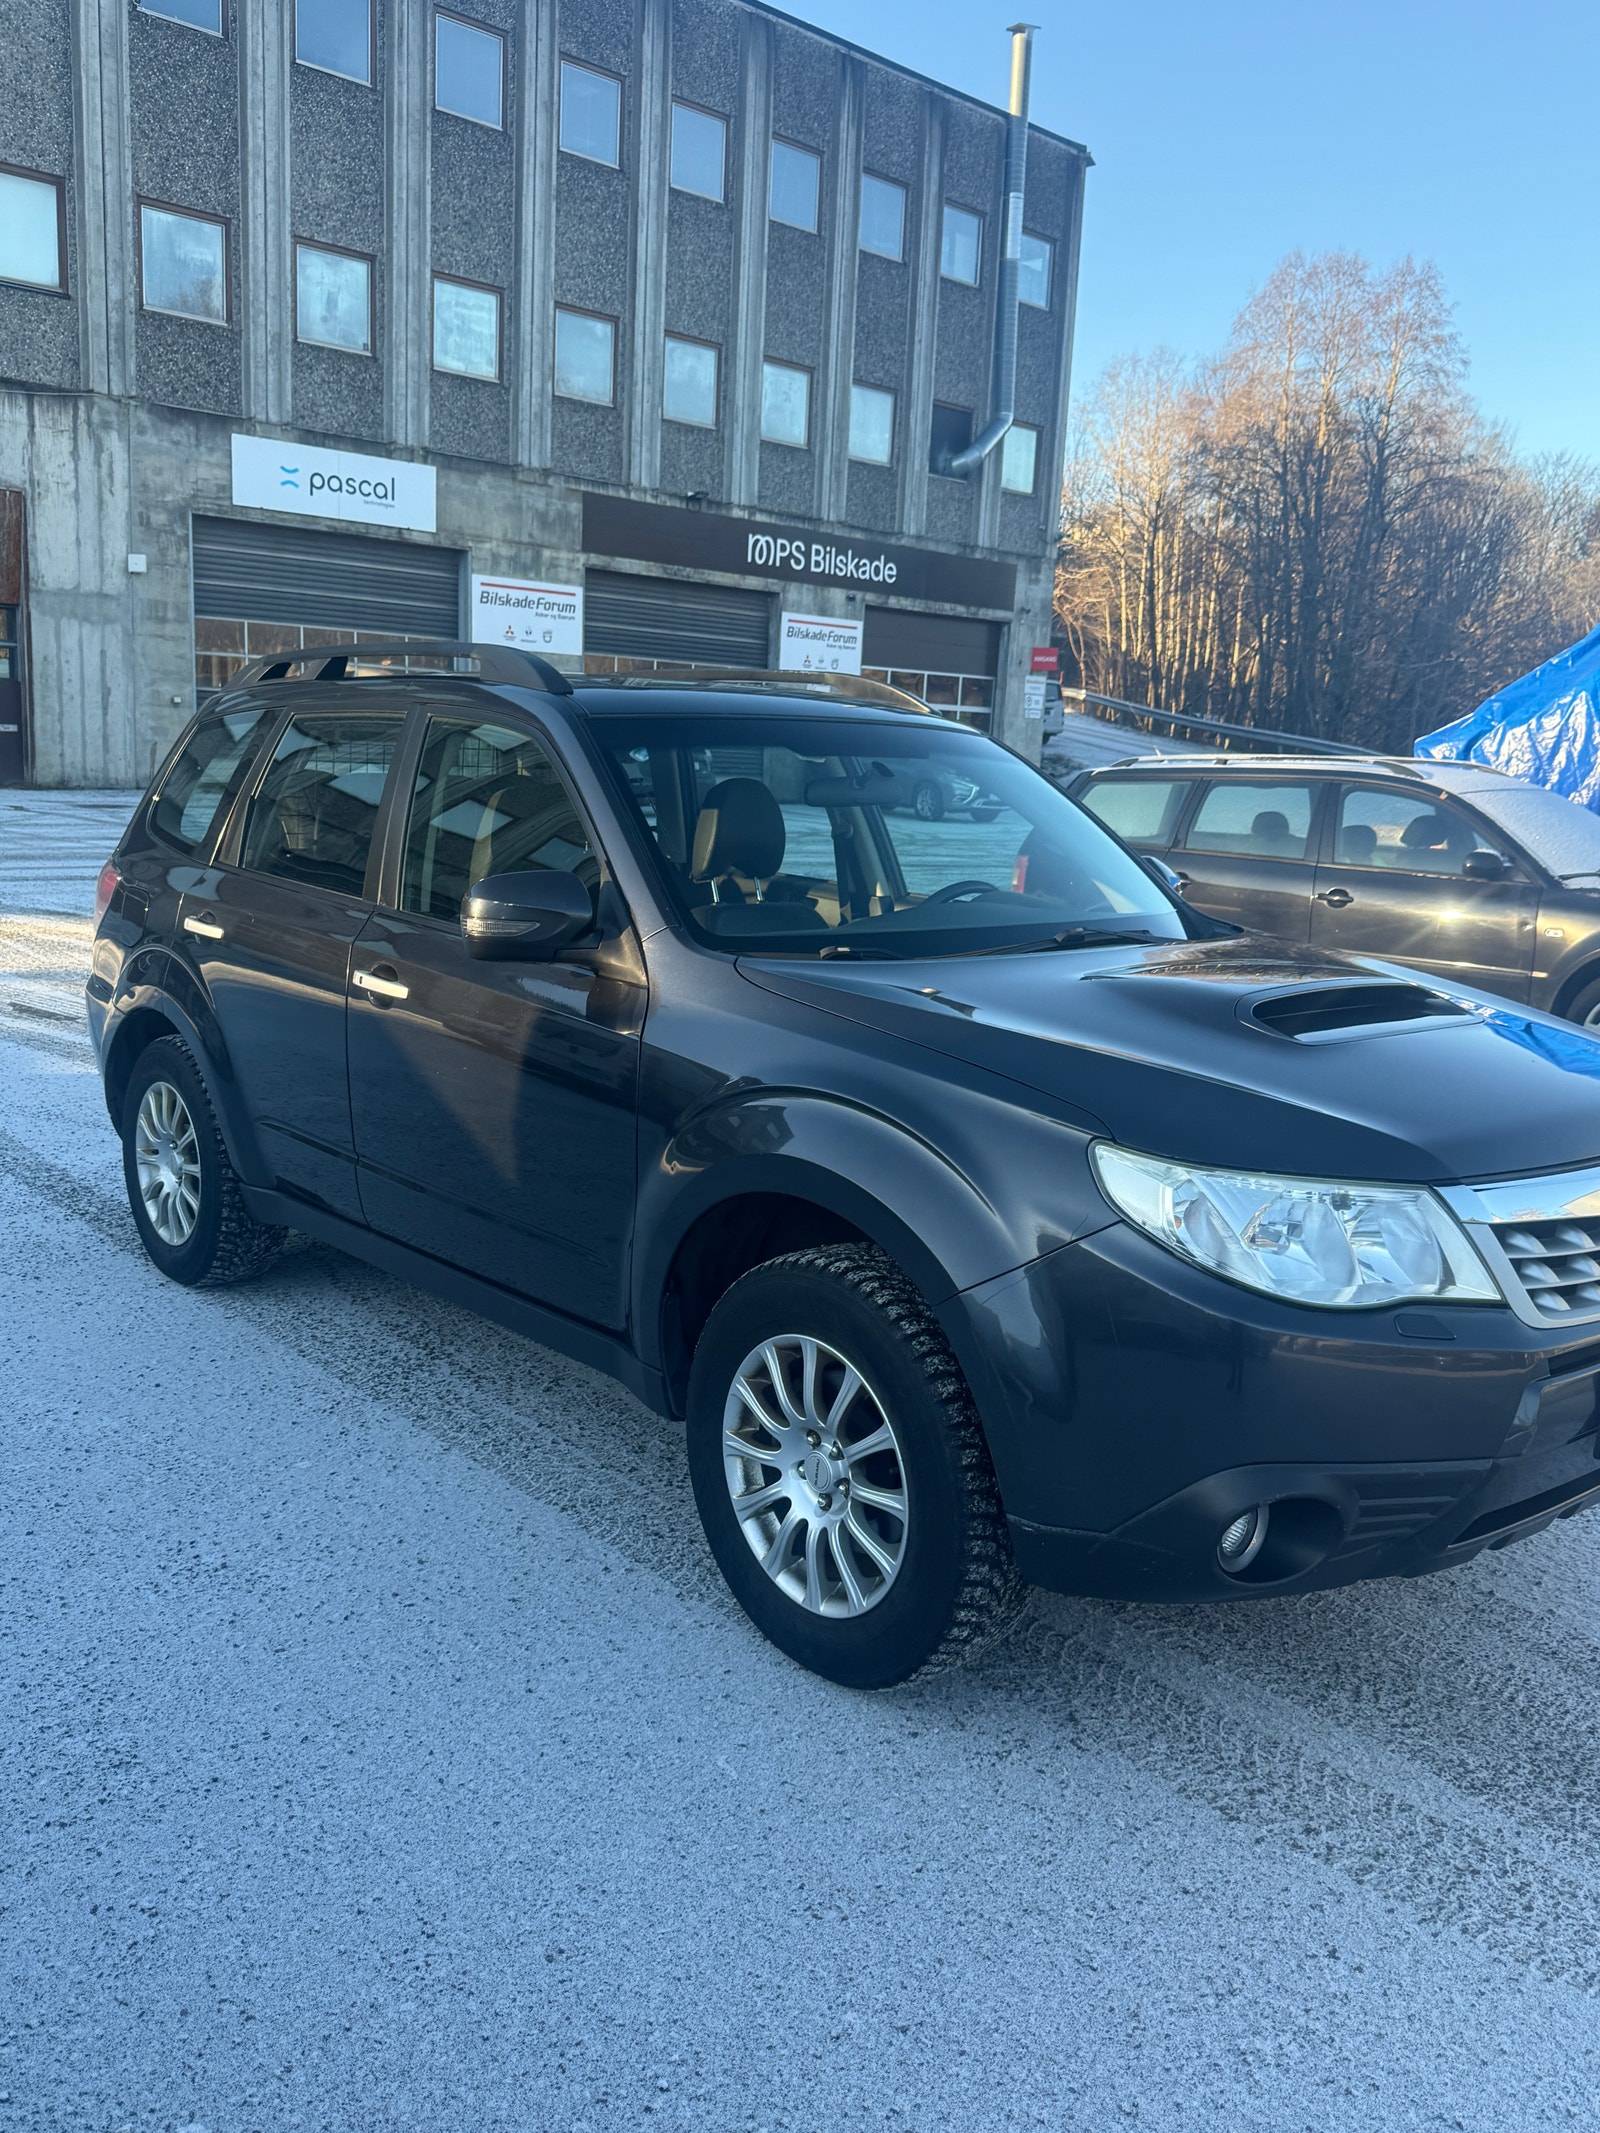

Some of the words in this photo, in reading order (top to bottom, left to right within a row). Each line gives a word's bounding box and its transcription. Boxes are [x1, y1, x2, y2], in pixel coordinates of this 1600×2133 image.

[309, 472, 395, 501] pascal
[810, 543, 897, 583] Bilskade
[480, 590, 576, 614] BilskadeForum
[787, 626, 857, 645] BilskadeForum
